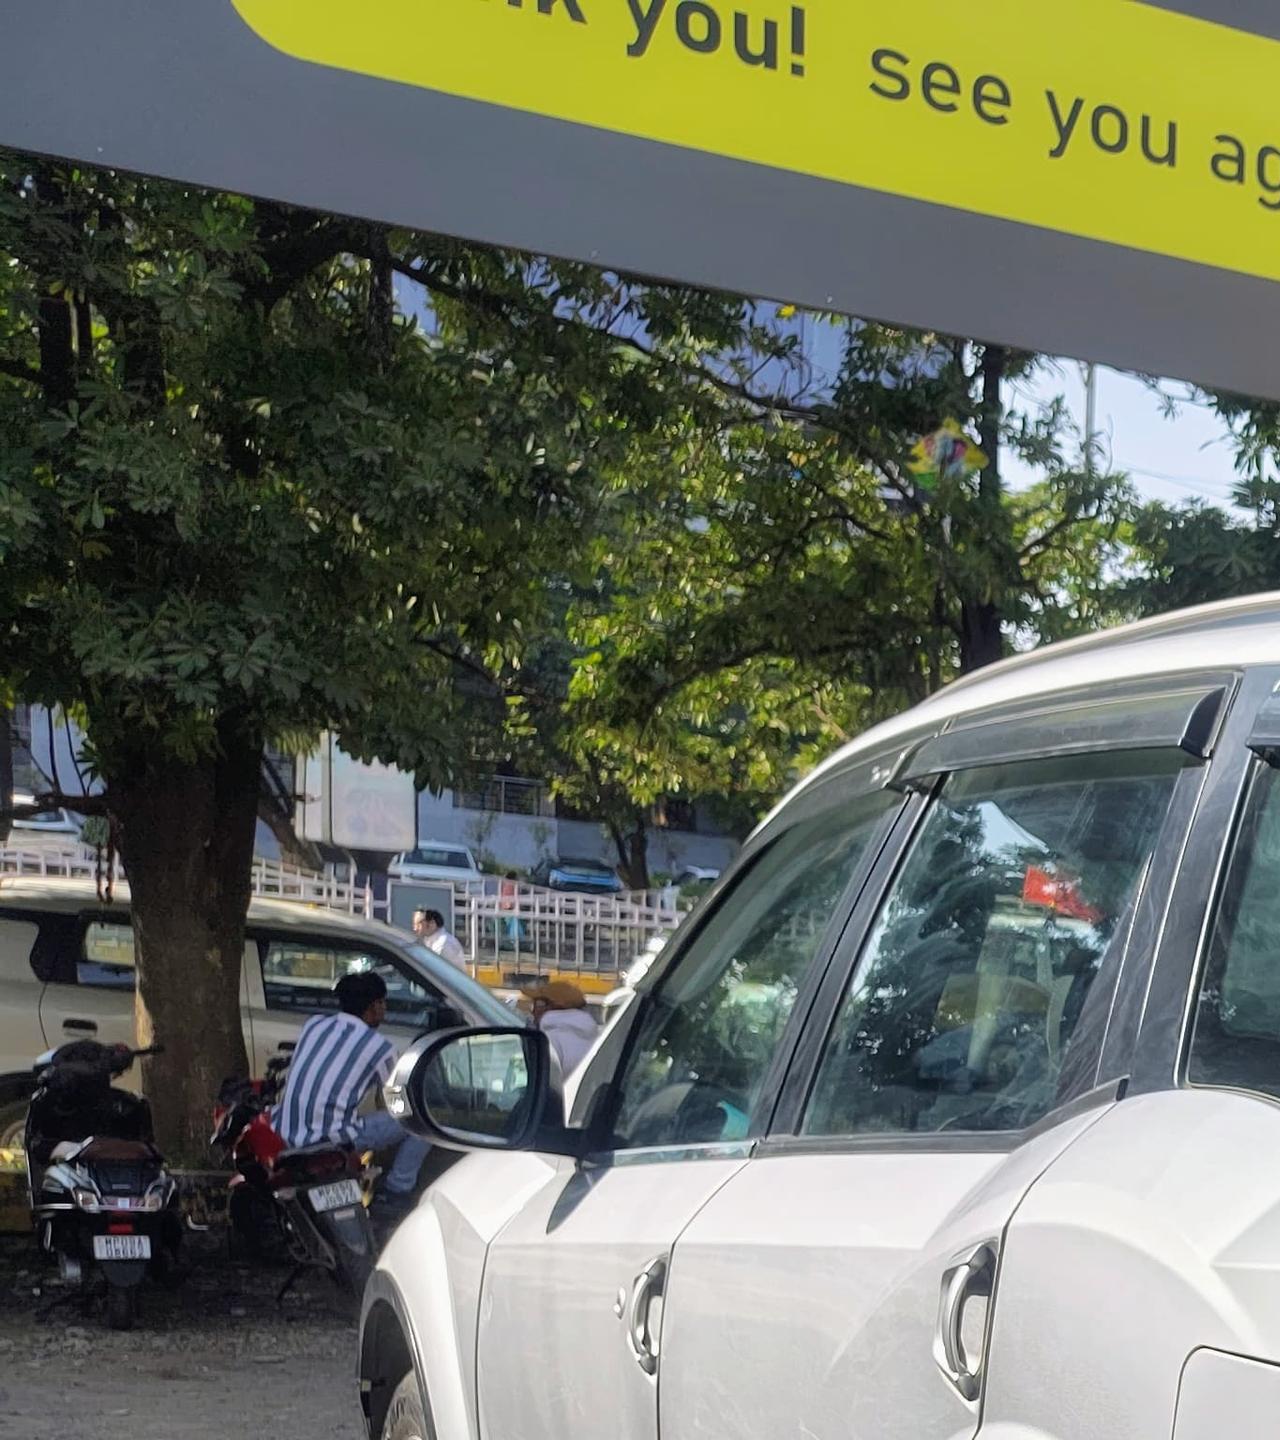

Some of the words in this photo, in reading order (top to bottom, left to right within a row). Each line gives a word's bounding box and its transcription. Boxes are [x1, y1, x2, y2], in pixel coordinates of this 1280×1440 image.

[627, 0, 805, 77] you!
[868, 47, 1012, 125] see
[1045, 89, 1178, 168] you
